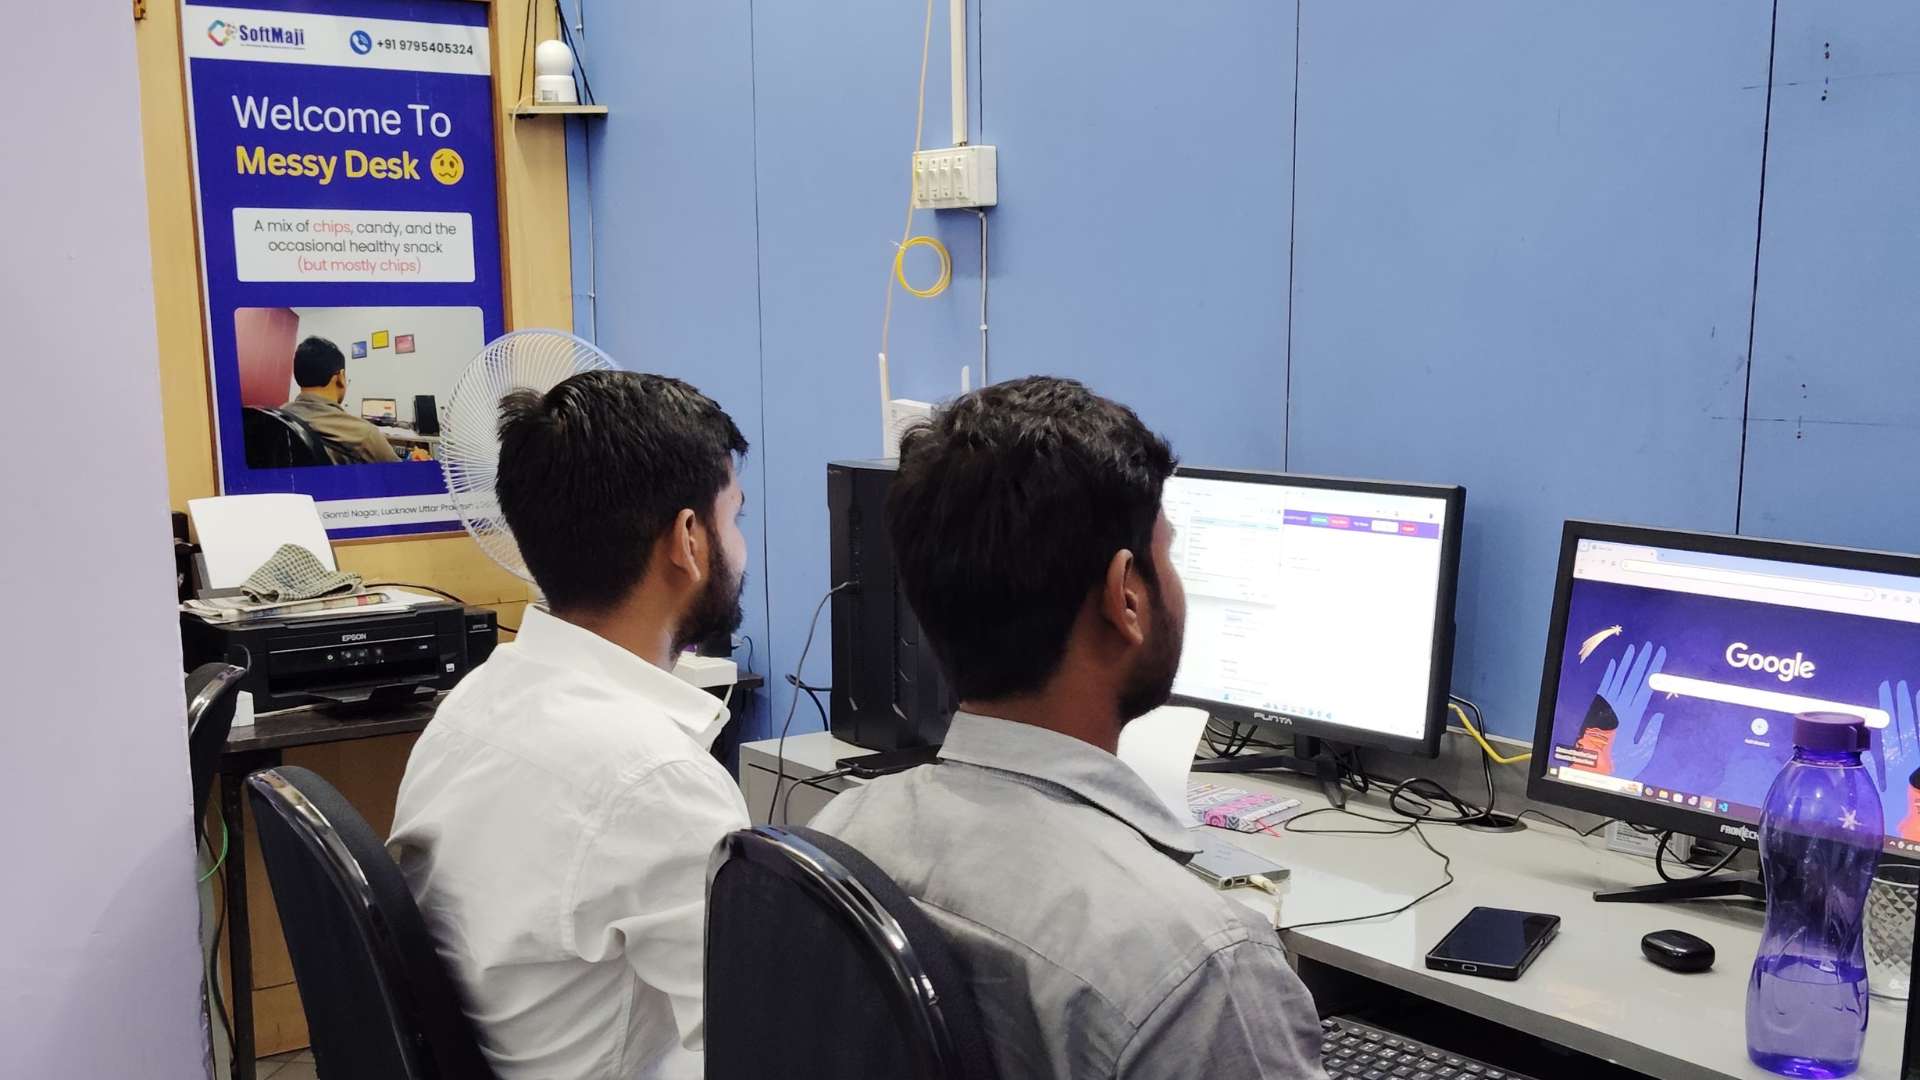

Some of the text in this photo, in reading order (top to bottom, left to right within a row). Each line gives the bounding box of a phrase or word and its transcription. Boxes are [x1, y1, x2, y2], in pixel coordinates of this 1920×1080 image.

[239, 24, 304, 46] SoftMaji
[377, 39, 473, 55] +91 9795405324
[232, 95, 452, 138] Welcome To
[235, 145, 421, 186] Messy Desk
[254, 219, 457, 238] A mix of chips, candy, and the
[268, 239, 443, 257] occasional healthy snack
[297, 256, 422, 275] (but mostly chips)
[341, 633, 367, 642] EPSON
[1725, 642, 1816, 682] Google
